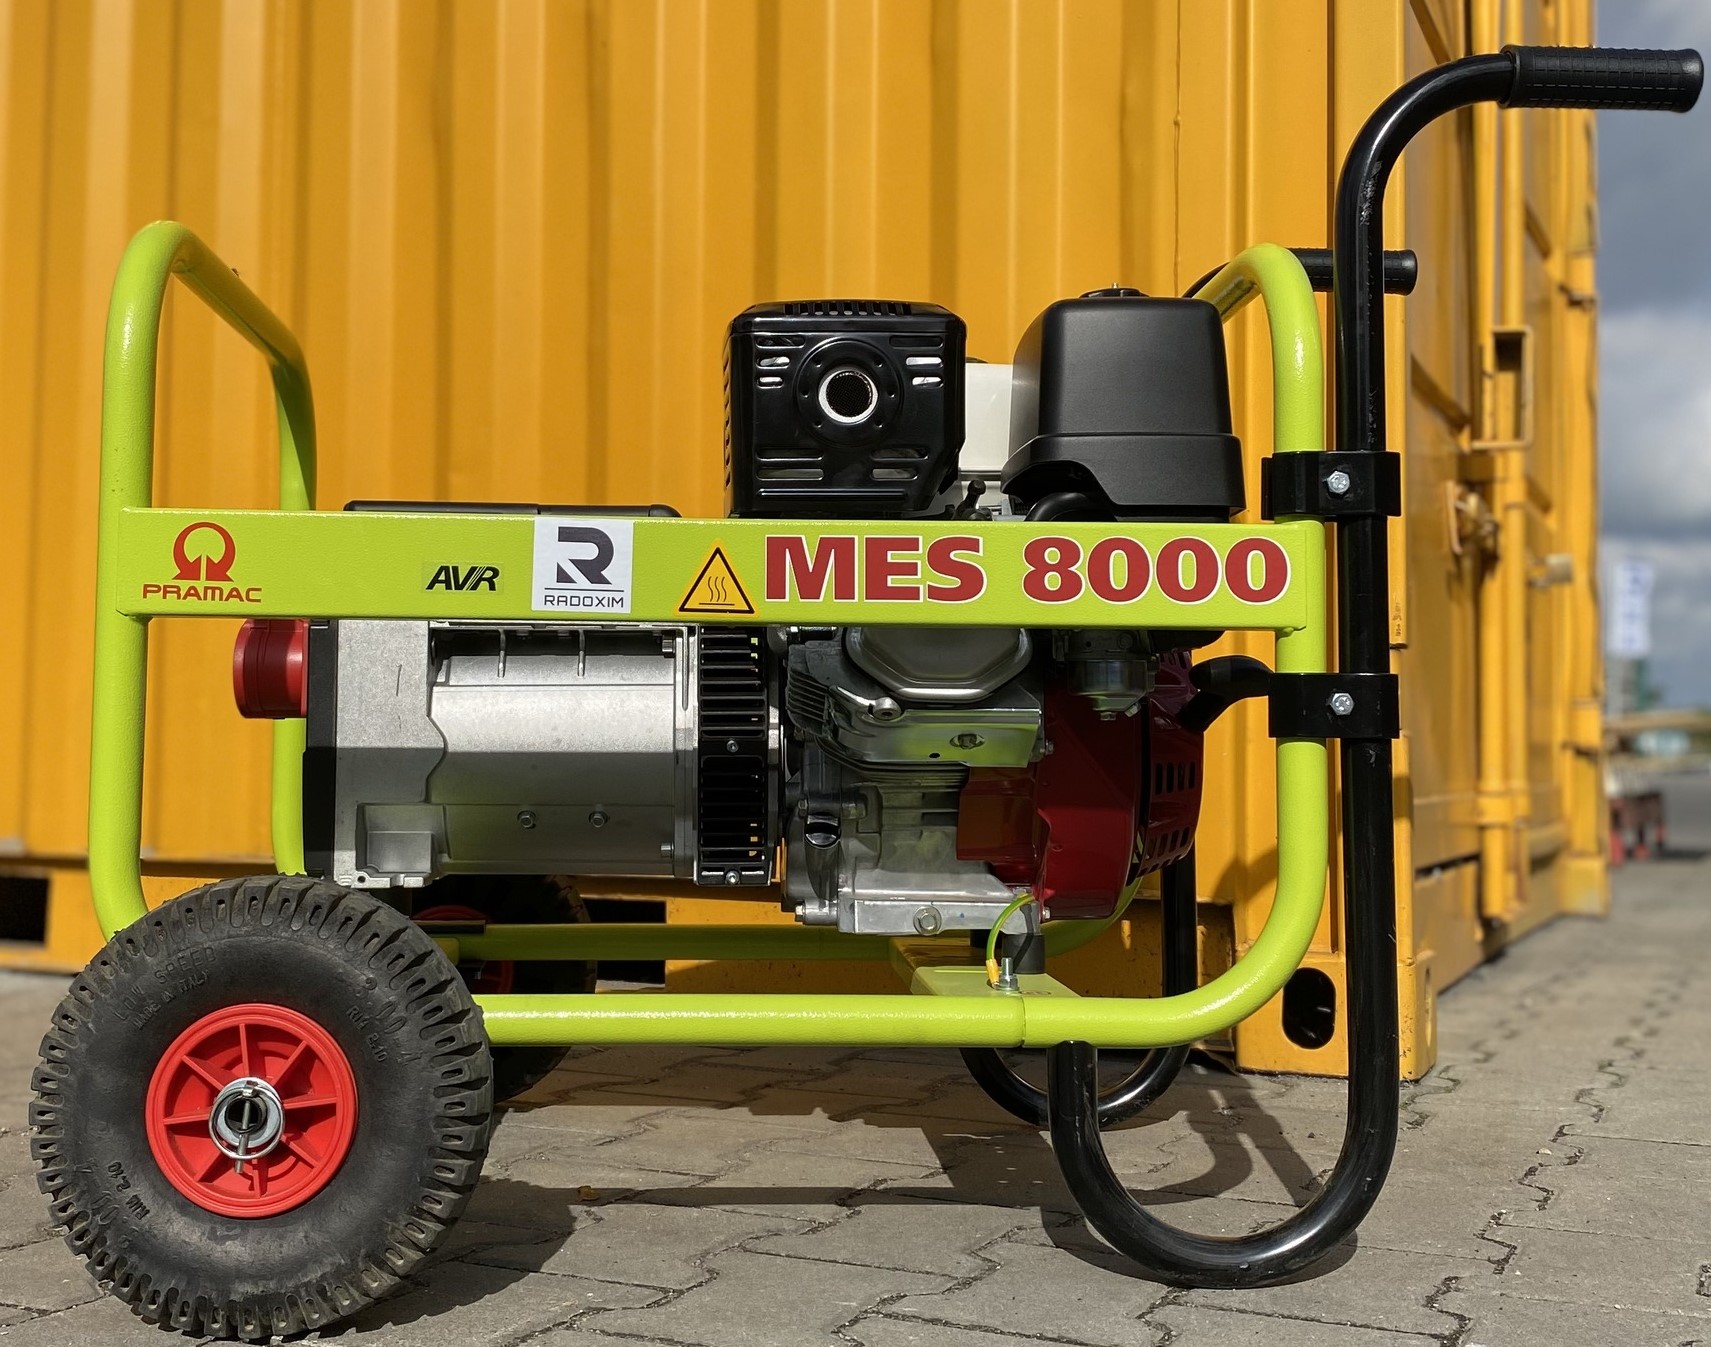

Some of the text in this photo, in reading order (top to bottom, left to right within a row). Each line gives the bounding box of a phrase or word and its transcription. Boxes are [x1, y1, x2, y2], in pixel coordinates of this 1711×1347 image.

[425, 565, 500, 591] AVR
[765, 534, 1291, 604] MES 8000
[142, 583, 263, 603] PRAMAC
[543, 594, 624, 608] RADOXIM
[154, 946, 216, 985] SPEED
[107, 1161, 151, 1221] RIM 2.10
